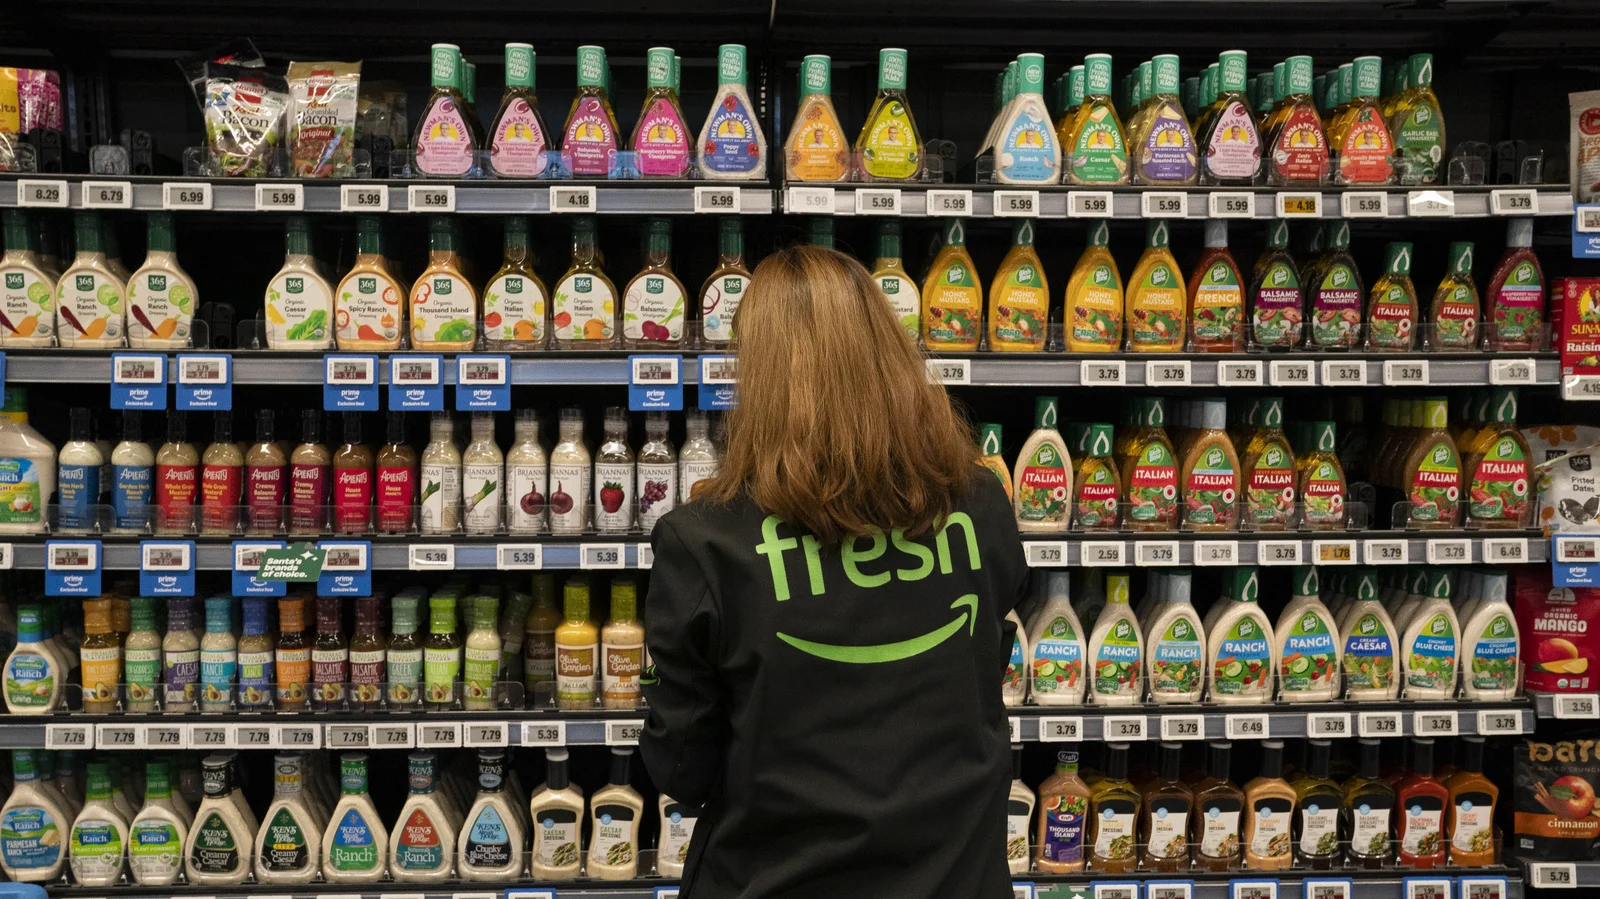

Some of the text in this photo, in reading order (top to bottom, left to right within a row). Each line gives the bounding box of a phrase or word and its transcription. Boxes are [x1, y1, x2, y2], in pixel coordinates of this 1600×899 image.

[221, 111, 269, 128] Bacon
[711, 112, 752, 139] NEWMAN'S OWN
[300, 129, 331, 139] Original
[35, 189, 59, 200] 8.29
[100, 190, 123, 201] 6.79
[180, 192, 203, 202] 6.99
[272, 193, 295, 204] 5.99
[358, 194, 380, 204] 5.99
[425, 194, 447, 204] 5.99
[569, 195, 589, 205] 4.18
[711, 196, 733, 205] 5.99
[872, 198, 894, 207] 5.99
[944, 199, 965, 208] 5.99
[1011, 200, 1032, 209] 5.99
[1510, 198, 1530, 207] 3.79
[1085, 201, 1105, 210] 5.99
[1159, 201, 1180, 210] 5.99
[1227, 201, 1247, 210] 5.99
[1297, 201, 1315, 210] 4.18
[1359, 201, 1380, 210] 5.99
[8, 276, 22, 284] 365
[288, 280, 302, 288] 365
[360, 280, 374, 288] 365
[507, 280, 521, 288] 365
[648, 280, 662, 288] 365
[436, 281, 450, 289] 365
[884, 281, 897, 290] 365
[1198, 294, 1239, 303] FRENCH
[349, 306, 366, 314] Spicy
[1377, 308, 1409, 316] ITALIAN
[1444, 307, 1473, 315] ITALIAN
[943, 368, 963, 377] 3.79
[1099, 369, 1119, 379] 3.79
[1164, 369, 1184, 378] 3.79
[1236, 369, 1256, 378] 3.79
[1288, 369, 1307, 378] 3.79
[1340, 370, 1360, 378] 3.79
[1402, 369, 1422, 378] 3.79
[1509, 368, 1529, 377] 3.79
[1572, 457, 1589, 466] 365
[1482, 463, 1524, 473] ITALIAN
[1026, 473, 1063, 482] ITALIAN
[1136, 470, 1173, 479] ITALIAN
[1419, 473, 1456, 482] ITALIAN
[1195, 476, 1232, 485] ITALIAN
[1255, 475, 1291, 484] ITALIAN
[1572, 476, 1594, 484] Pitted
[1041, 550, 1060, 559] 3.79
[1098, 550, 1118, 559] 2.59
[1152, 550, 1172, 559] 3.79
[1212, 549, 1231, 558] 3.79
[1276, 549, 1295, 558] 3.79
[1333, 549, 1350, 558] 1.78
[1382, 548, 1401, 557] 3.79
[1445, 548, 1464, 557] 3.79
[1500, 547, 1521, 556] 6.49
[514, 553, 534, 562] 5.39
[597, 552, 617, 561] 5.39
[1534, 619, 1587, 632] MANGO
[1291, 637, 1330, 647] RANCH
[1041, 646, 1076, 655] RANCH
[1104, 647, 1137, 656] RANCH
[1226, 642, 1265, 652] RANCH
[1162, 649, 1196, 657] RANCH
[559, 654, 579, 664] Olive
[609, 655, 630, 664] Olive
[561, 663, 591, 673] Garden
[612, 663, 640, 673] Garden
[1572, 703, 1592, 712] 3.59
[1242, 722, 1262, 731] 6.49
[1325, 722, 1344, 731] 3.79
[1376, 721, 1395, 730] 3.79
[1432, 720, 1451, 728] 3.79
[1496, 719, 1515, 728] 3.79
[1057, 725, 1076, 734] 3.79
[1121, 725, 1140, 733] 3.79
[1178, 724, 1197, 733] 3.79
[64, 732, 84, 742] 7.79
[114, 732, 134, 742] 7.79
[159, 732, 179, 742] 7.79
[205, 732, 225, 741] 7.79
[249, 732, 269, 741] 7.79
[293, 732, 313, 741] 7.79
[343, 732, 363, 741] 7.79
[387, 732, 407, 741] 7.79
[435, 731, 454, 740] 7.79
[481, 731, 501, 740] 7.79
[538, 730, 558, 739] 5.39
[1548, 818, 1598, 829] cinnamon
[272, 826, 297, 834] KEN'S
[475, 845, 501, 853] Chunky
[200, 851, 230, 859] Creamy
[271, 850, 298, 858] Creamy
[336, 849, 372, 861] Ranch
[405, 852, 435, 862] Ranch
[470, 852, 507, 860] Blue Cheese
[1550, 872, 1569, 881] 5.79
